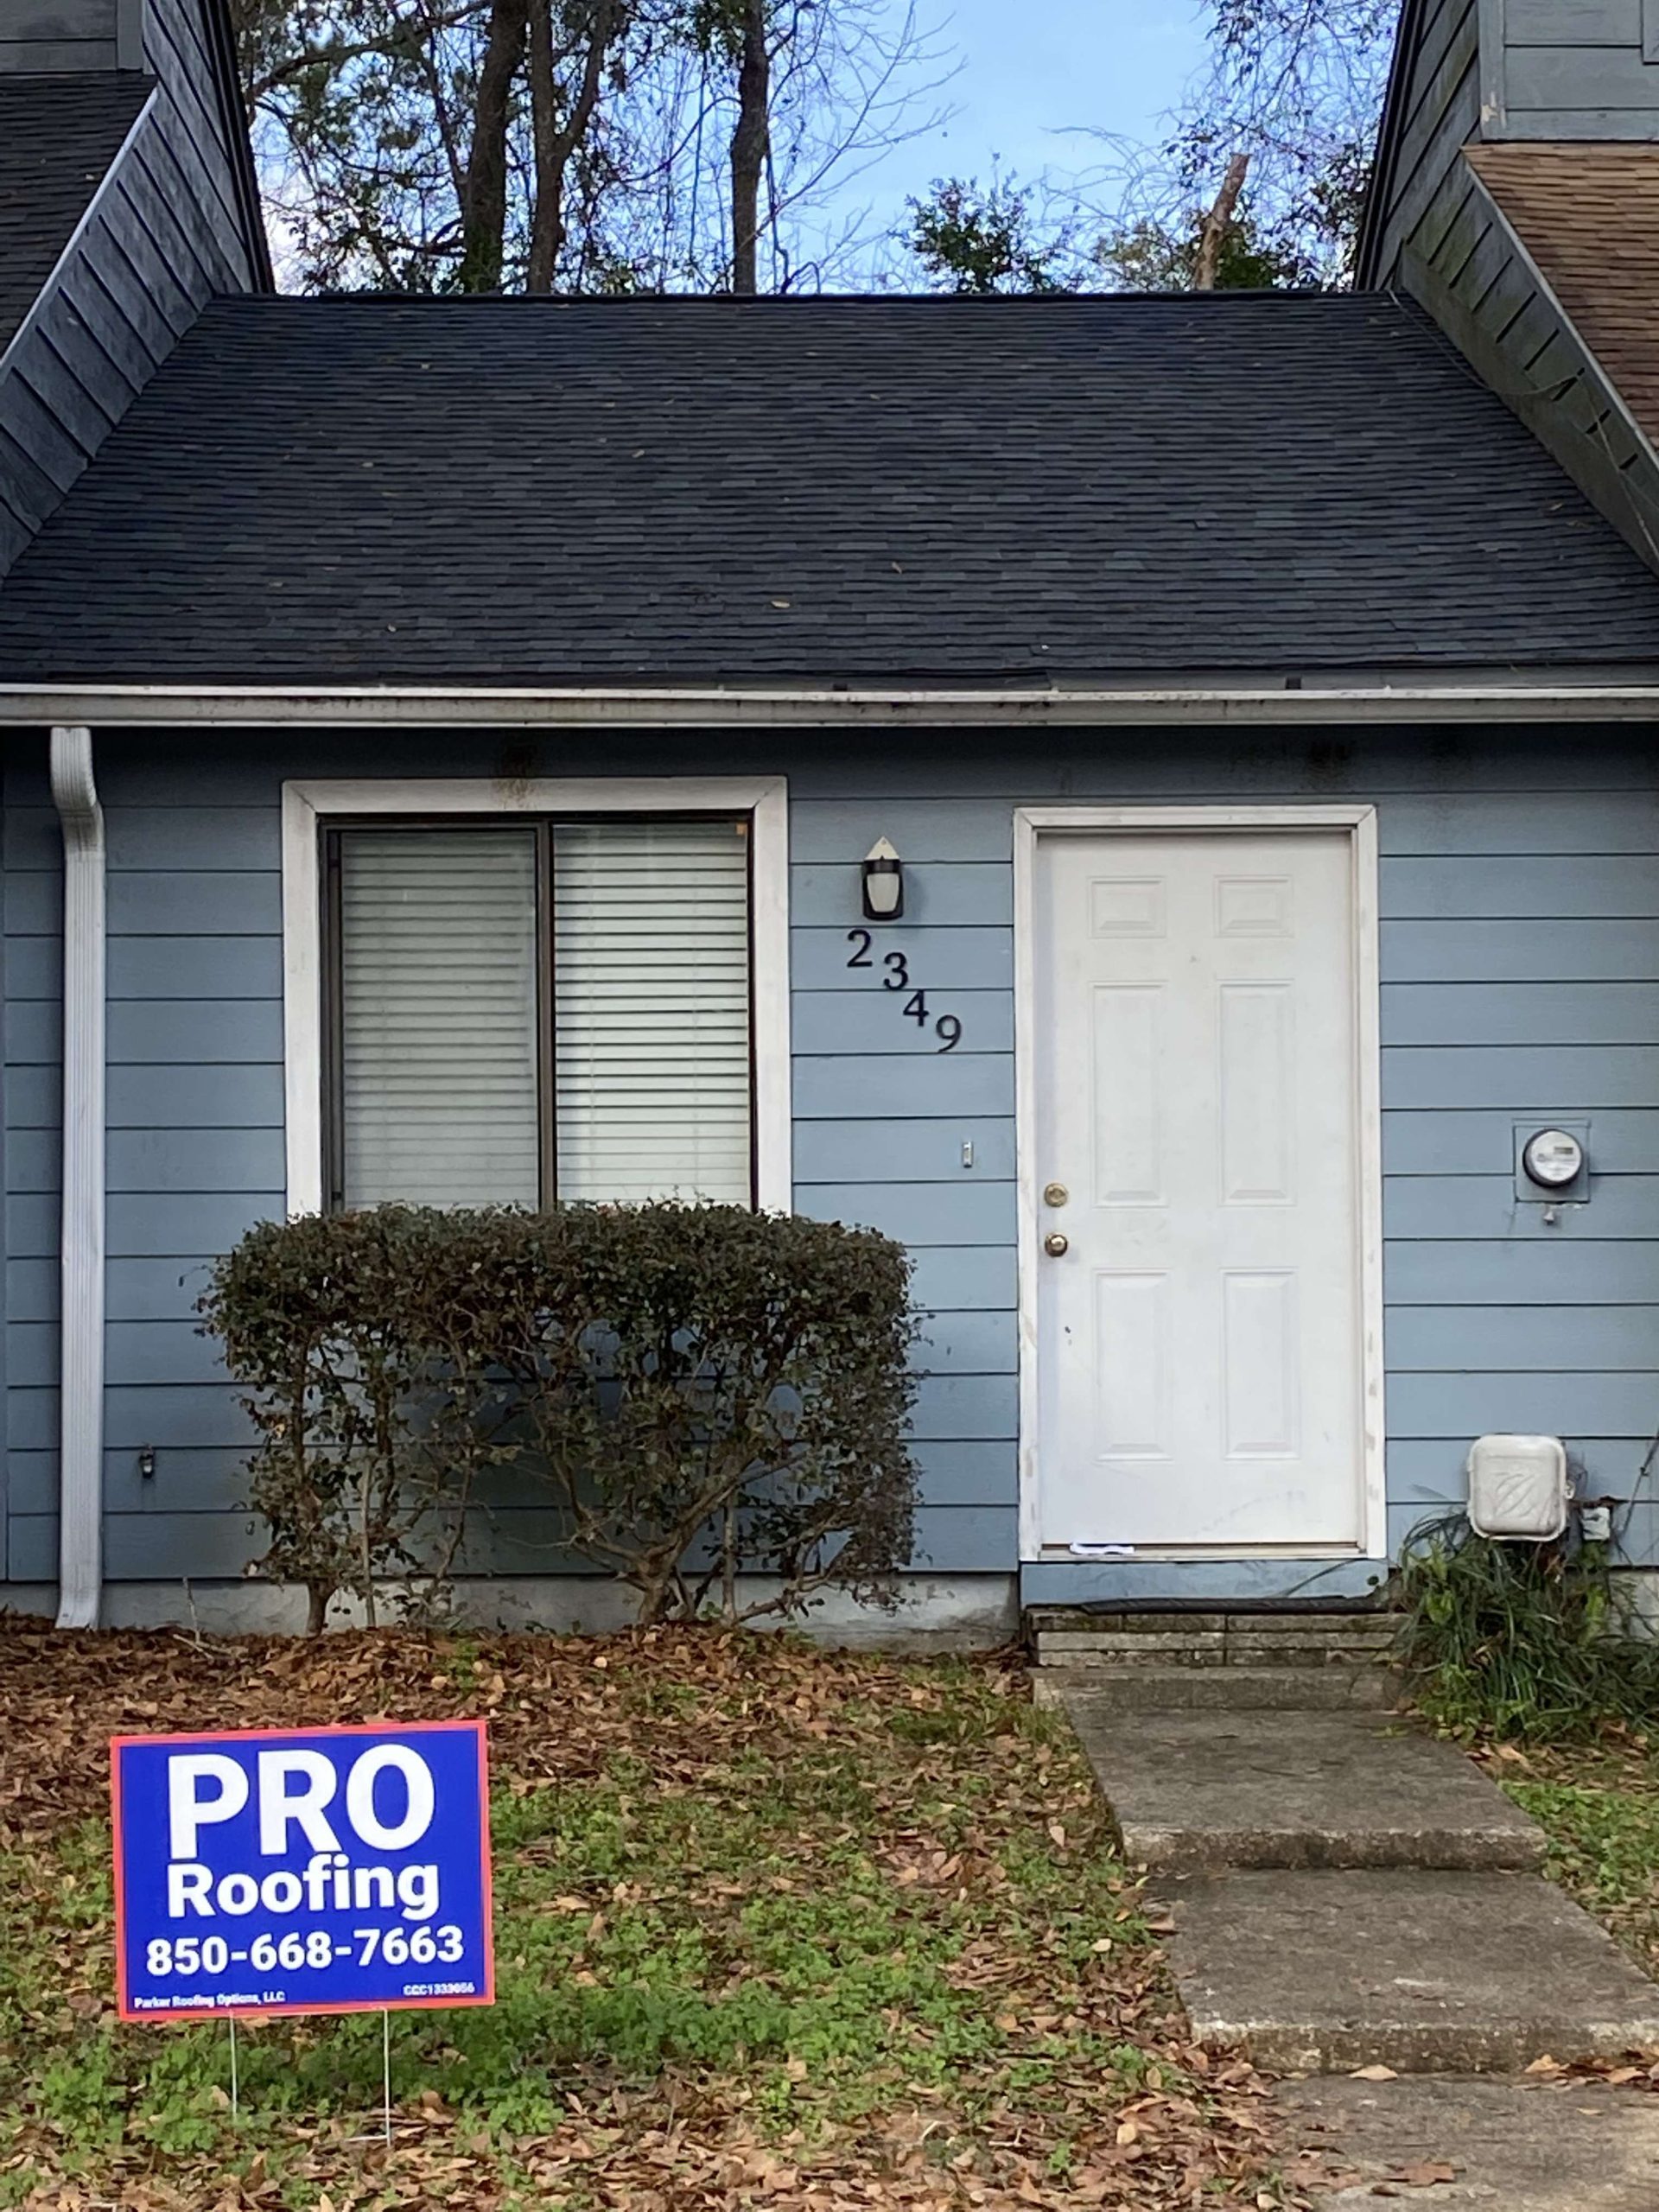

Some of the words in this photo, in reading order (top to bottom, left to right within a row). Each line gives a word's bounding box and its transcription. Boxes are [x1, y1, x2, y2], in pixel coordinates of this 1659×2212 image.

[847, 929, 962, 1053] 2349
[168, 1744, 435, 1859] PRO
[167, 1853, 440, 1920] Roofing
[146, 1925, 464, 1976] 850-668-7663
[134, 1997, 171, 2008] Parker
[173, 1994, 215, 2008] Roofing
[263, 1991, 286, 2003] LLC
